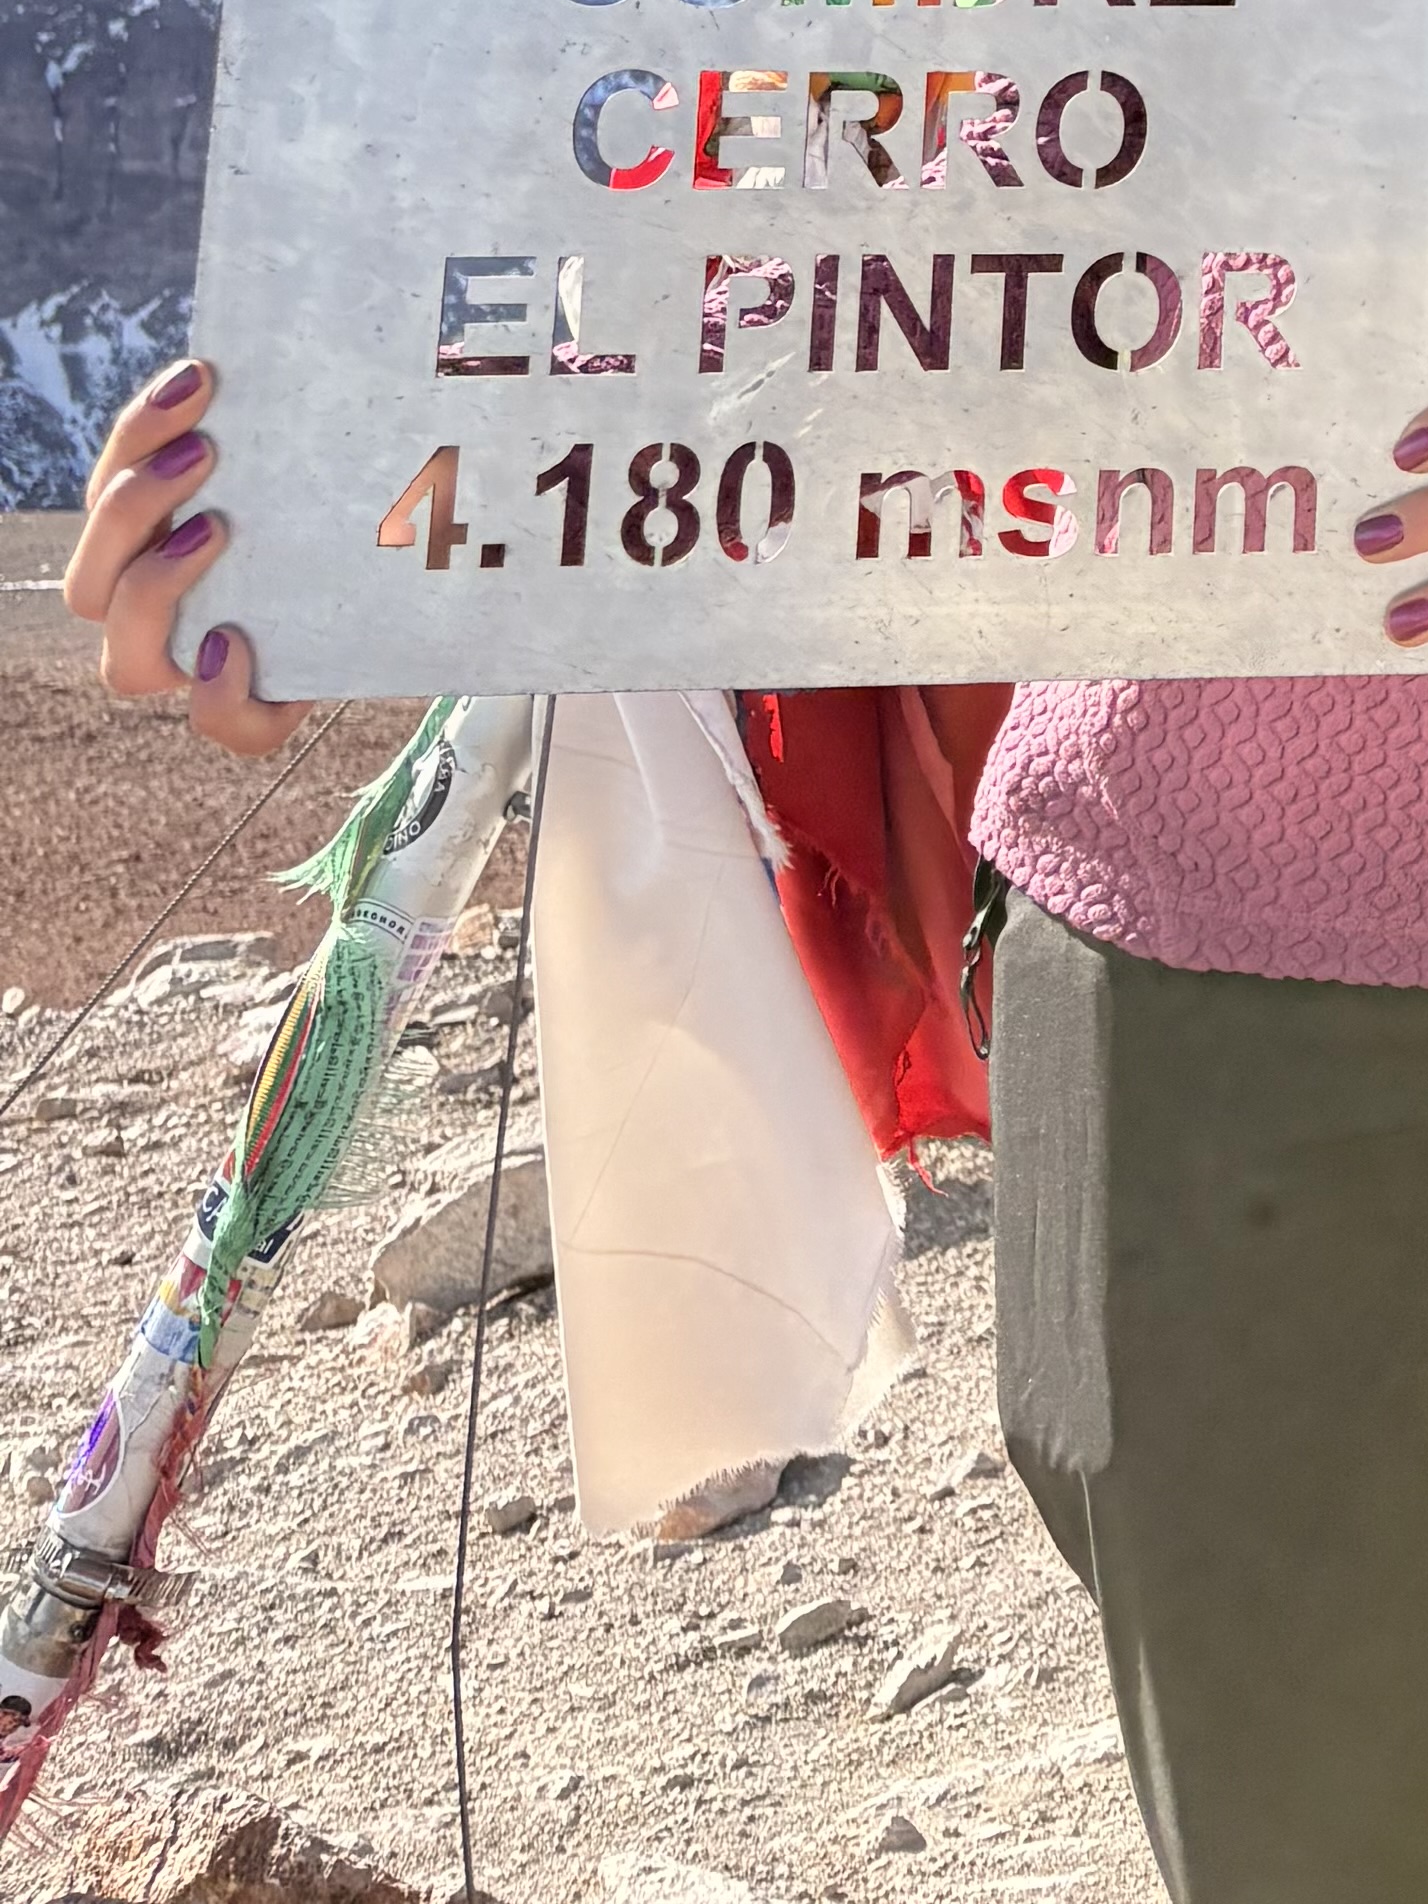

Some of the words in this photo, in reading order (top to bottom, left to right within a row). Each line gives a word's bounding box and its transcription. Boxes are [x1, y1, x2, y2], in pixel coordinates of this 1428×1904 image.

[572, 68, 1148, 191] CERRO
[435, 255, 638, 377] EL
[698, 250, 1303, 374] PINTOR
[376, 439, 797, 570] 4.180
[855, 466, 1320, 562] msnm
